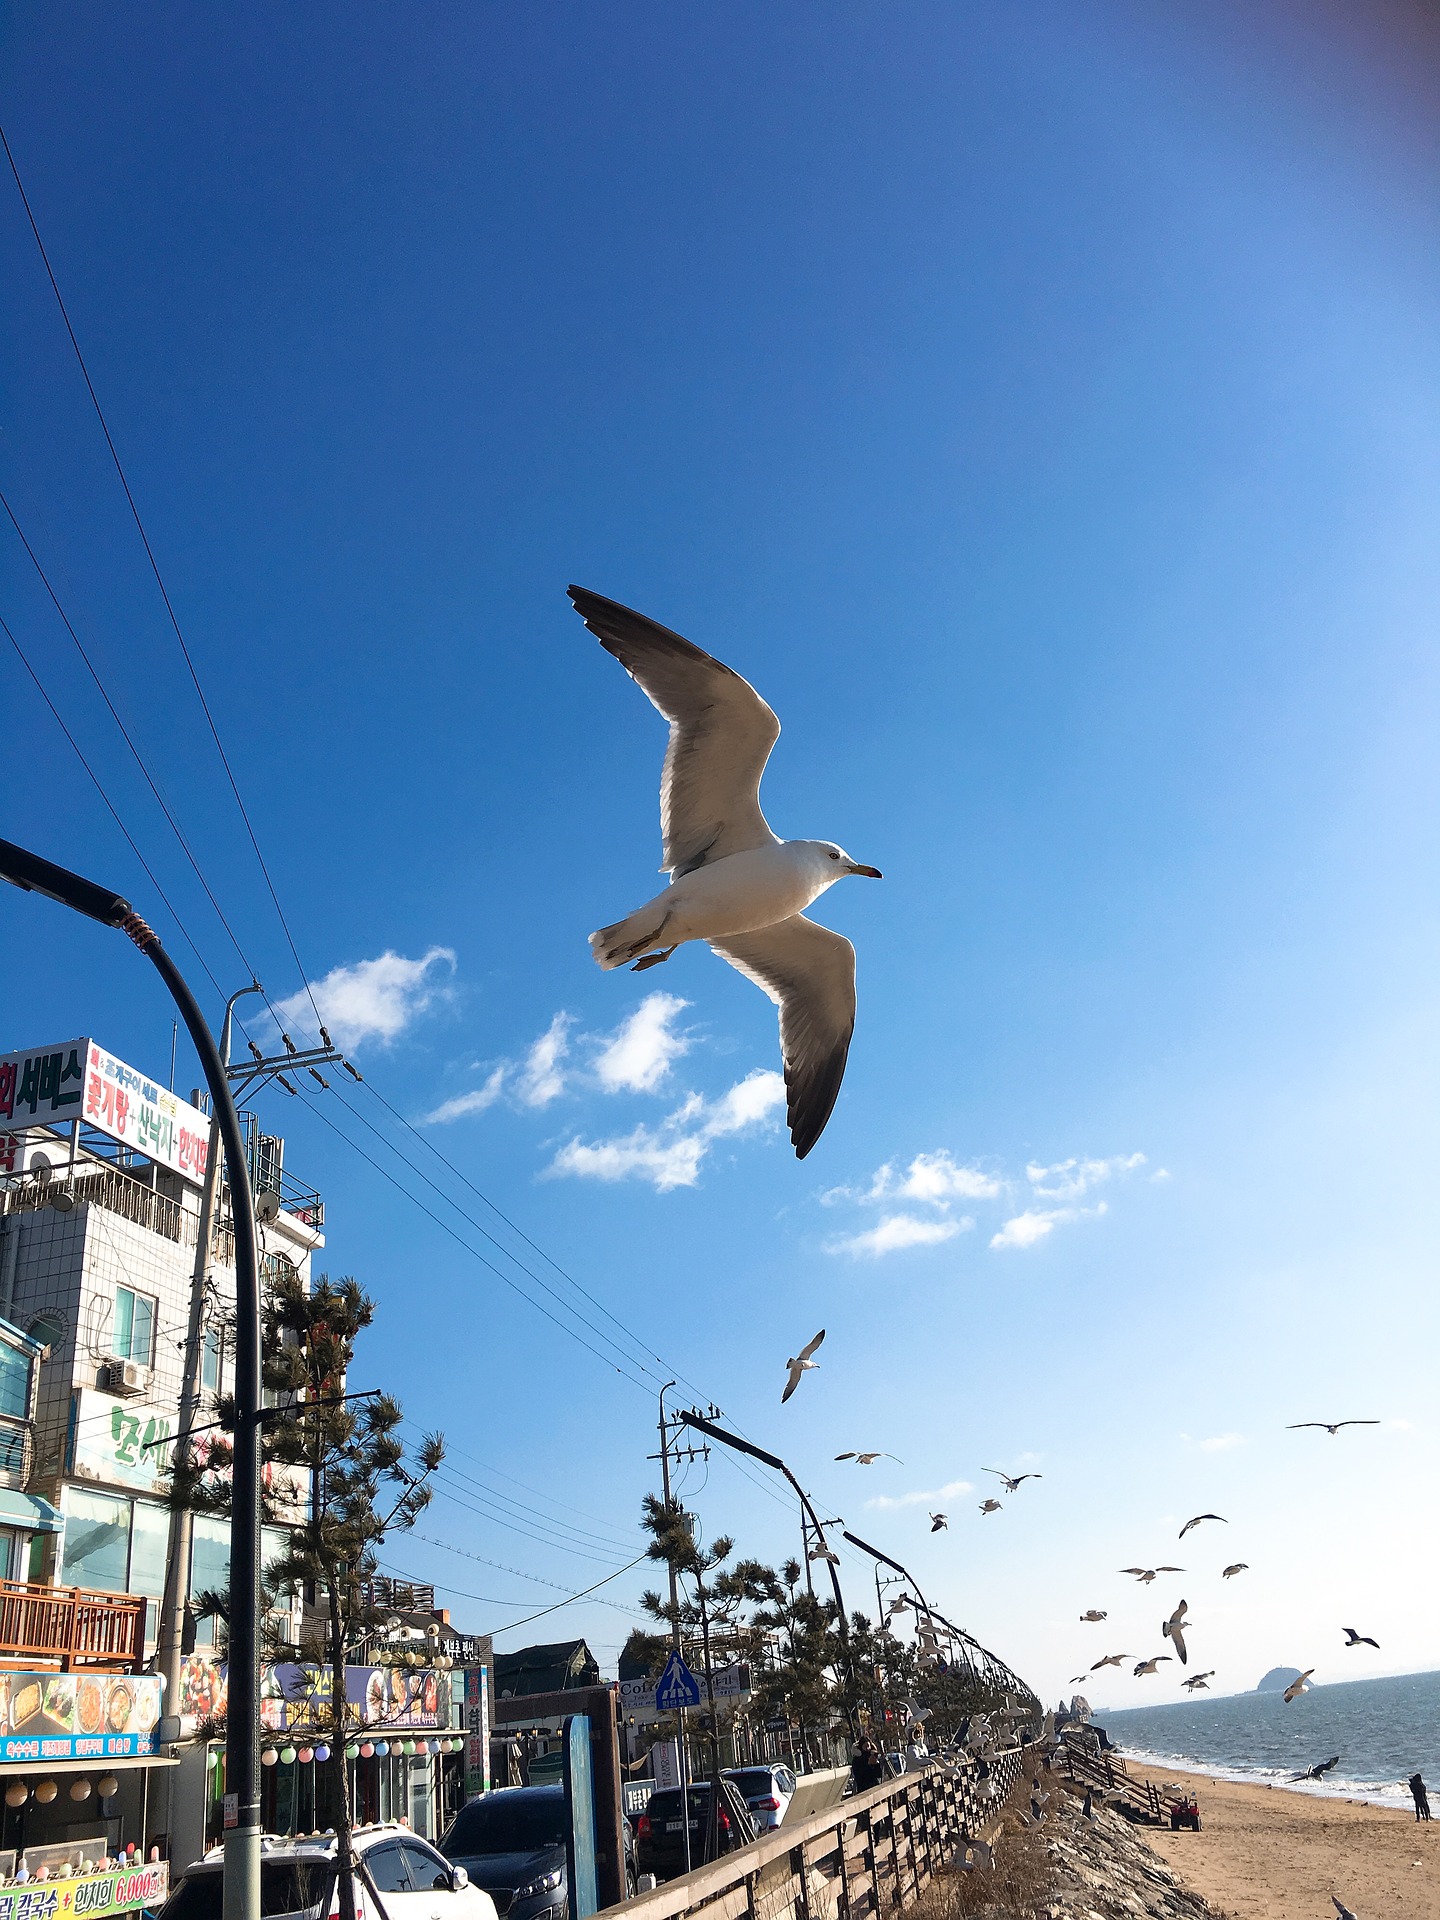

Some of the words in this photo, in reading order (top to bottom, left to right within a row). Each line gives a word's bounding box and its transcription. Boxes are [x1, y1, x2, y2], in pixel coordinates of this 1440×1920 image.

[16, 1049, 82, 1114] 서비스
[87, 1071, 129, 1135] 꽃게탕
[138, 1103, 173, 1161] 산낙지
[662, 1697, 695, 1708] 횡단보도
[7, 1741, 39, 1758] 옥수수콘
[17, 1889, 58, 1920] 칼국수
[74, 1879, 113, 1913] 한치회
